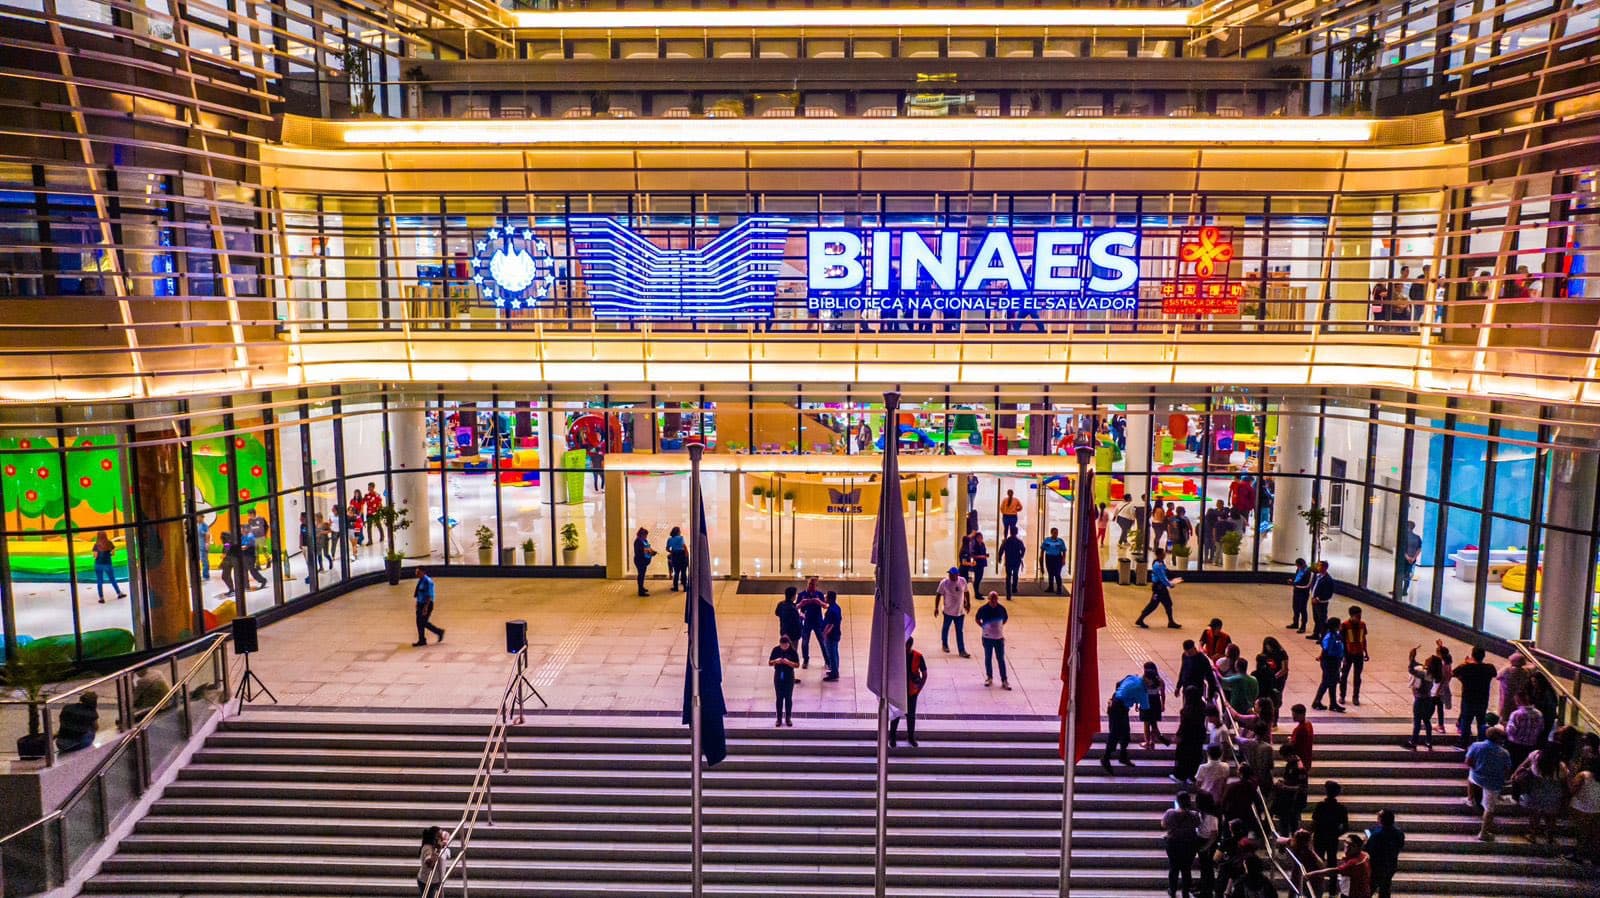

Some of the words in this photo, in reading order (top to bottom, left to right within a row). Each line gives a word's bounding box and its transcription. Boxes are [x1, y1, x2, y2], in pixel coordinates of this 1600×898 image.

[808, 231, 1139, 292] BINAES
[808, 297, 903, 310] BIBLIOTECA
[908, 297, 995, 310] NACIONAL
[998, 297, 1020, 310] DE
[1023, 297, 1042, 310] EL
[1045, 297, 1136, 310] SALVADOR
